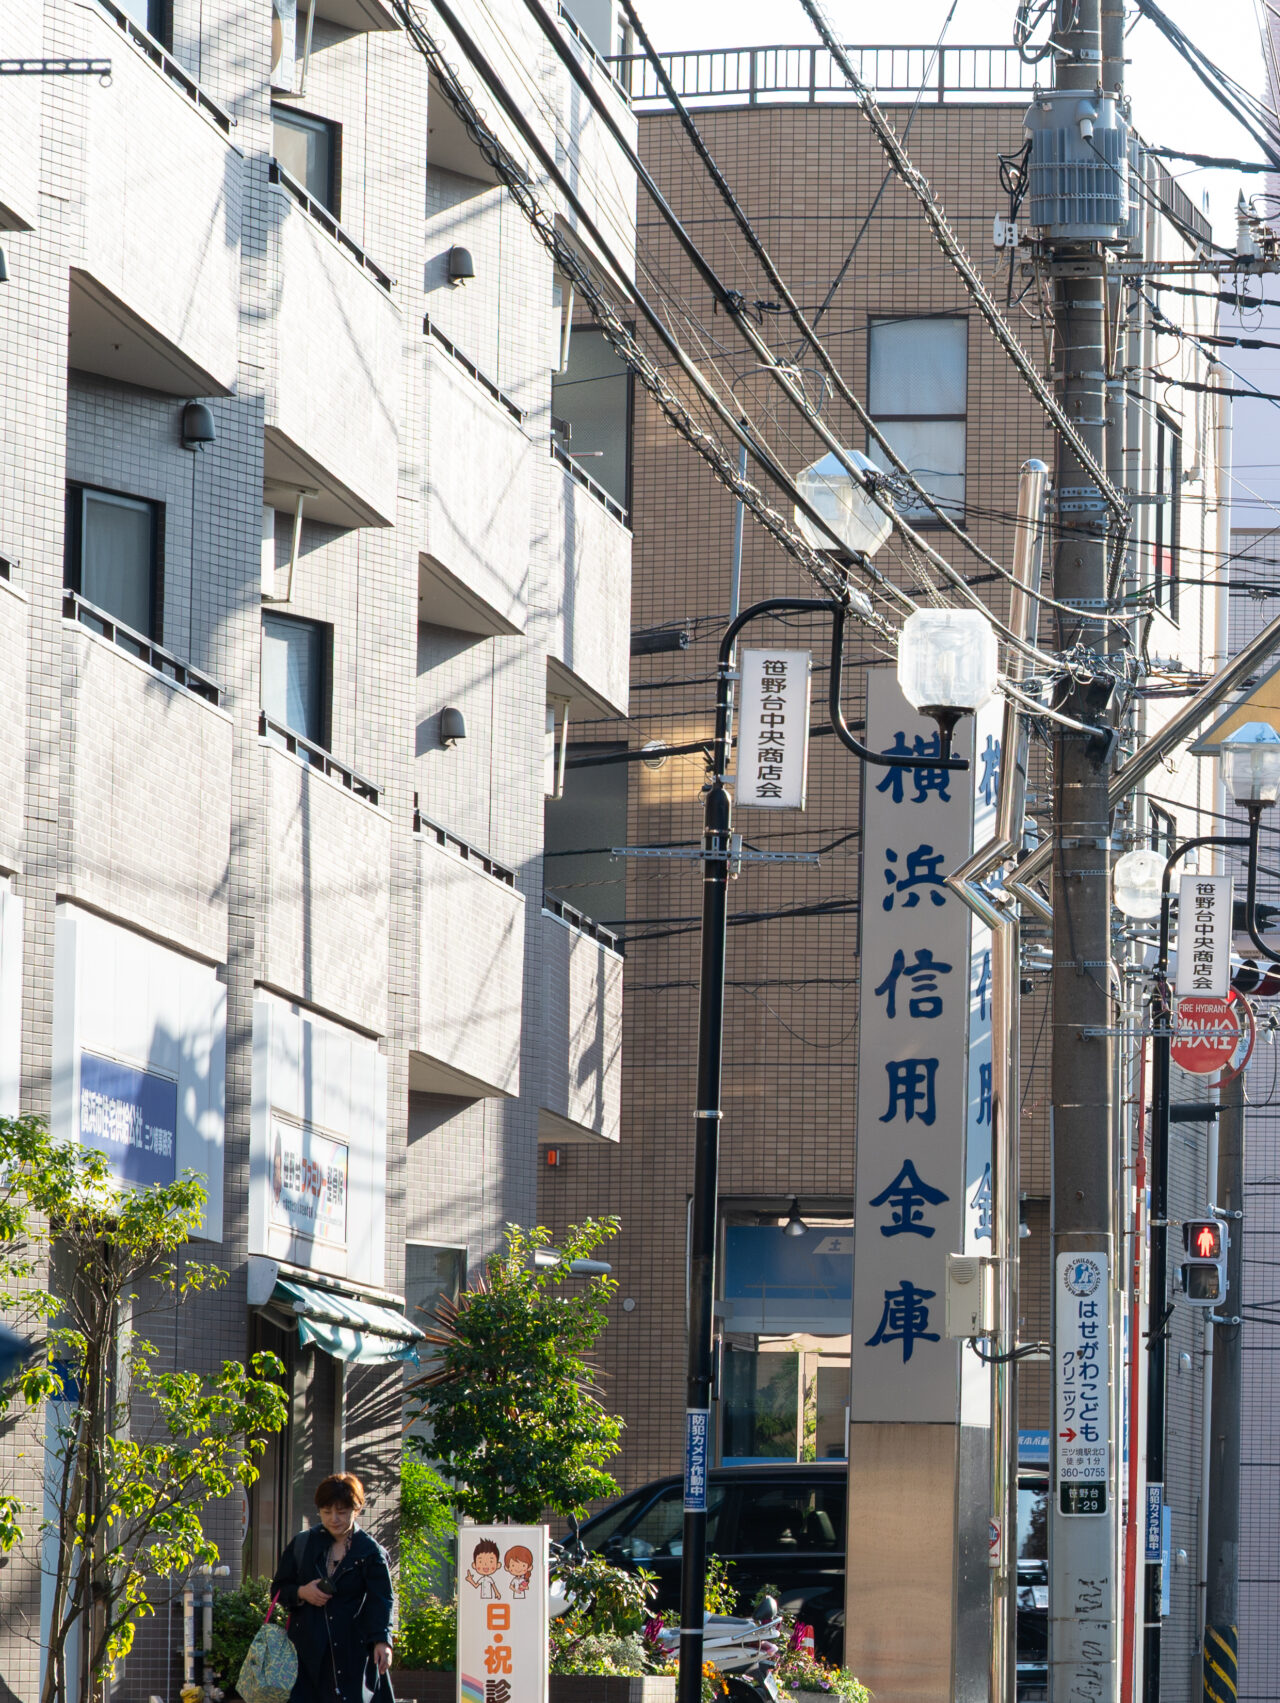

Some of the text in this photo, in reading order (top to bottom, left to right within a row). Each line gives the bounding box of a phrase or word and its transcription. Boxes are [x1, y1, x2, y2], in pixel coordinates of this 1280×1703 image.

[755, 659, 788, 799] 笹野台中央商店会
[1193, 883, 1216, 990] 笹野台中央商店会
[1178, 1003, 1227, 1014] FIRE HYDRANT
[864, 730, 960, 1365] 横浜信用金庫
[1171, 1018, 1234, 1050] 消火栓
[1088, 1276, 1101, 1296] CLINIC
[1063, 1351, 1076, 1422] クリニック
[1078, 1301, 1100, 1443] はせがわこども
[690, 1415, 706, 1497] 防犯カメラ作動中
[1061, 1448, 1106, 1457] 三ツ境駅北口
[1061, 1467, 1106, 1478] 360-0755
[1069, 1488, 1099, 1498] 笹野台
[1071, 1501, 1098, 1511] 1-29
[1148, 1487, 1160, 1550] 防犯カメラ作動中
